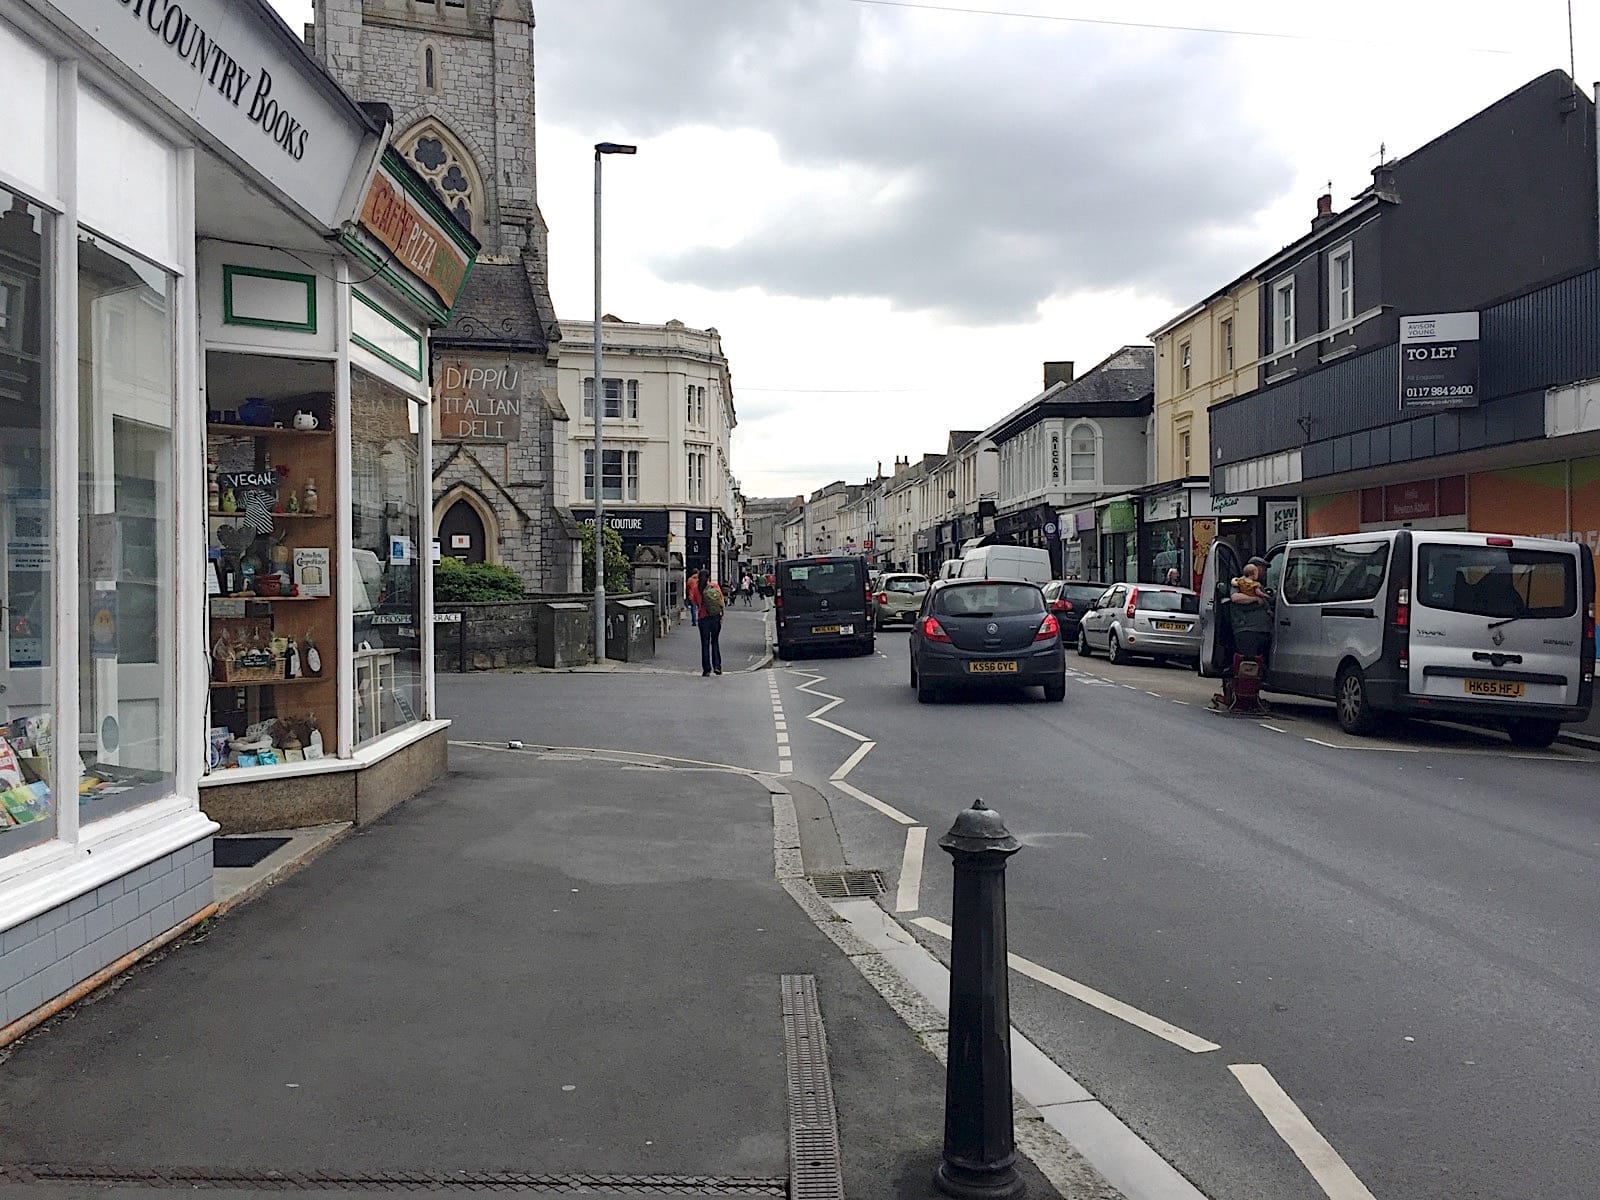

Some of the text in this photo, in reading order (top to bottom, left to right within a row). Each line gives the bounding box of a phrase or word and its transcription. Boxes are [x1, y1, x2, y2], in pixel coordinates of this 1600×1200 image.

[119, 0, 251, 106] COUNTRY
[403, 221, 438, 277] PIZZA
[1406, 346, 1458, 360] TO LET
[1406, 385, 1474, 397] 0117 984 2400
[443, 397, 520, 417] ITALIAN
[459, 420, 504, 438] DELI
[227, 474, 272, 487] VEGAN
[1274, 508, 1298, 522] KWI
[610, 518, 643, 529] COUTURE
[380, 614, 412, 623] PROSPE
[973, 662, 1015, 671] KS56 GYC
[1468, 681, 1521, 694] HK65 HFJ
